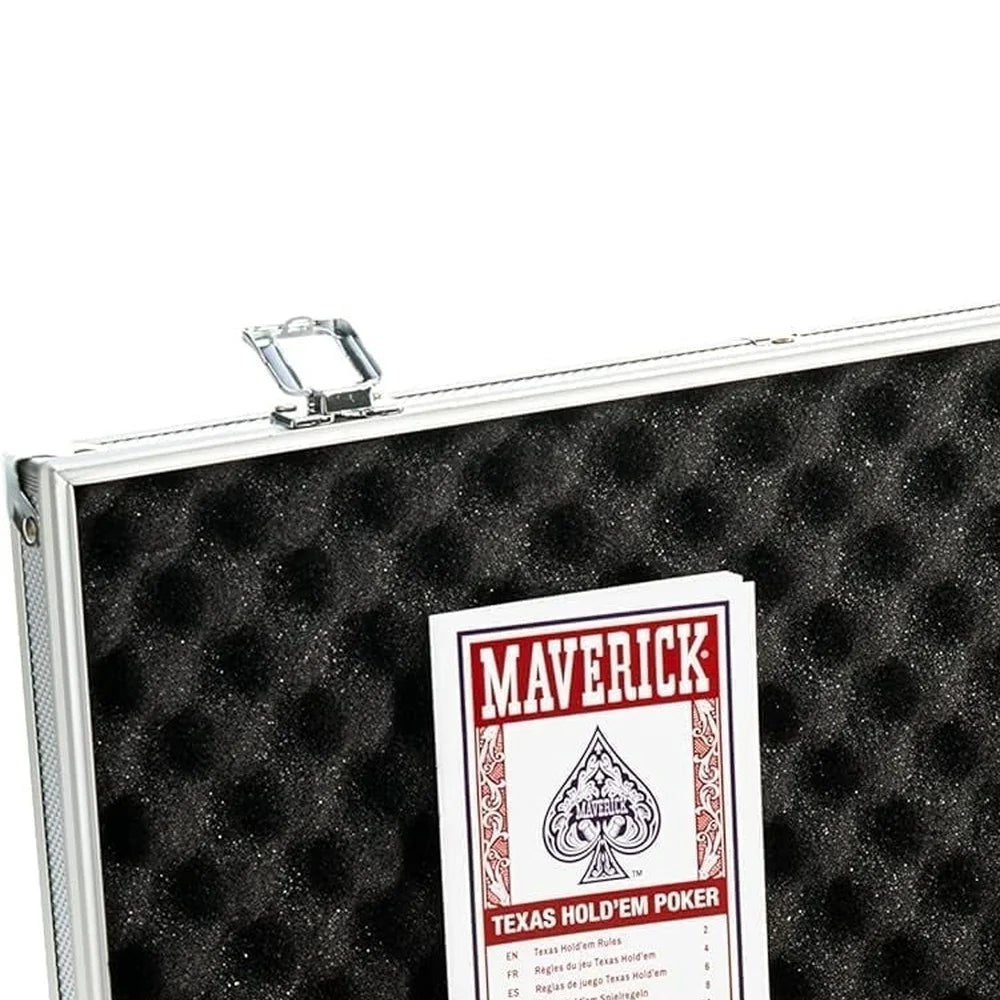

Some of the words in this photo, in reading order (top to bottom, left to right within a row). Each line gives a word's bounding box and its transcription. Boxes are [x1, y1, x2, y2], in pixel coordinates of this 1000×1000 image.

[479, 621, 709, 720] MAVERICK
[491, 908, 557, 936] TEXAS
[561, 896, 649, 926] HOLD'EM
[654, 886, 720, 914] POKER
[506, 952, 519, 961] EN
[534, 947, 559, 956] Texas
[598, 938, 623, 947] Rules
[704, 925, 709, 934] 2
[507, 970, 520, 979] FR
[566, 962, 577, 970] du
[579, 962, 593, 971] jeu
[594, 957, 620, 966] Texas
[508, 988, 520, 998] ES
[536, 983, 565, 994] Reglas
[567, 981, 578, 989] de
[579, 978, 605, 989] juego
[606, 974, 631, 983] Texas
[704, 962, 711, 970] 6
[705, 981, 712, 989] 8
